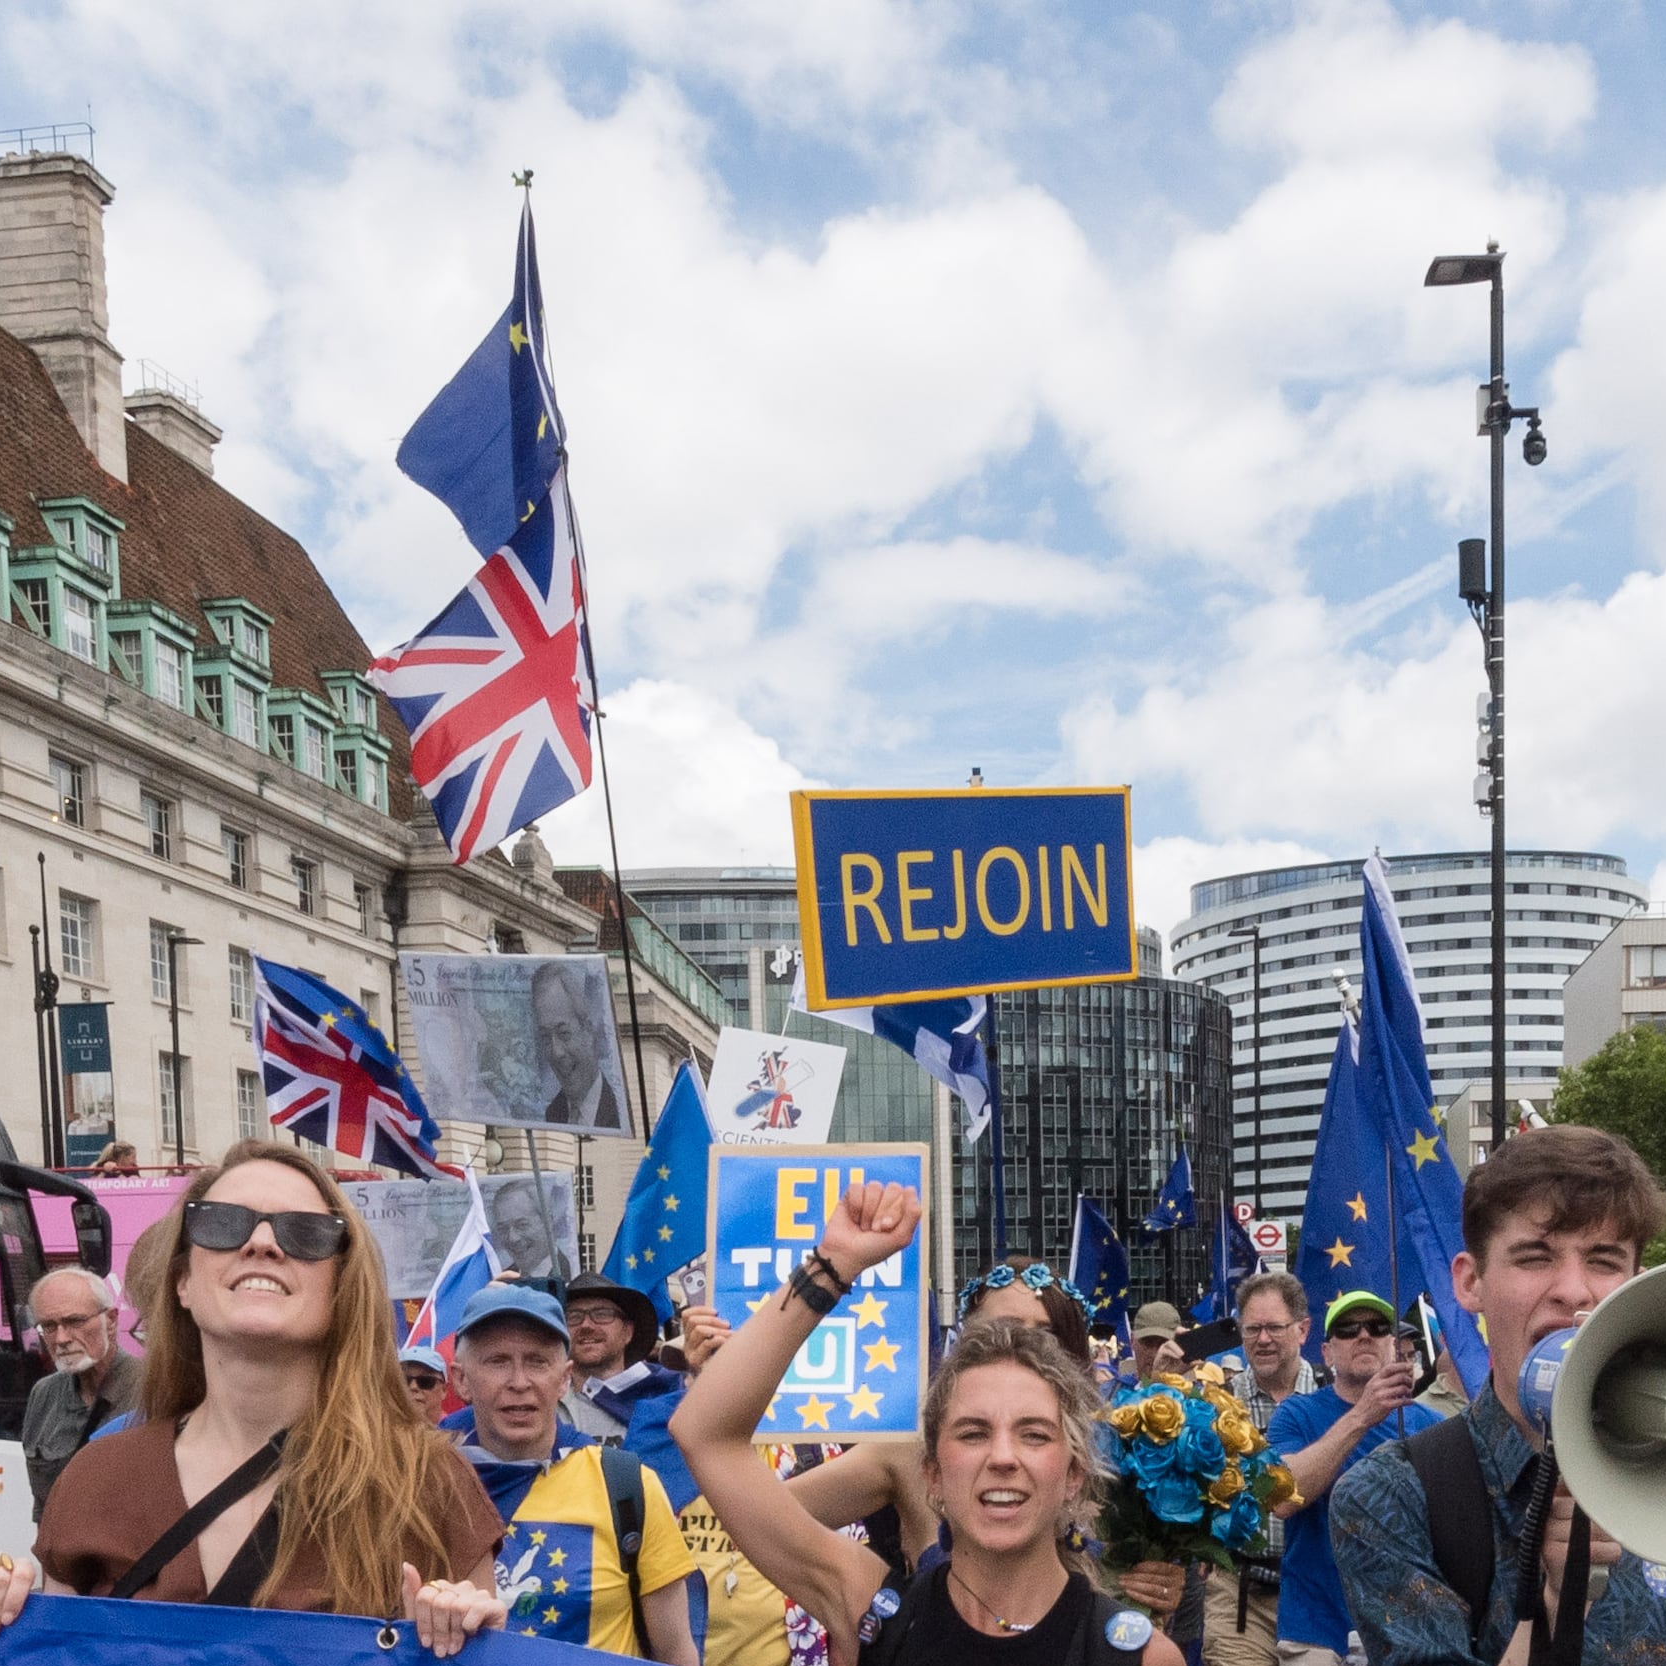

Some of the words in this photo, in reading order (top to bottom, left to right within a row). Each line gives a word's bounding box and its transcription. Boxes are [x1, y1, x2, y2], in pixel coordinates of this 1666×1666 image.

[840, 843, 1108, 947] REJOIN
[408, 991, 459, 1008] MILLION
[151, 1178, 170, 1188] ART
[731, 1248, 902, 1287] TUN
